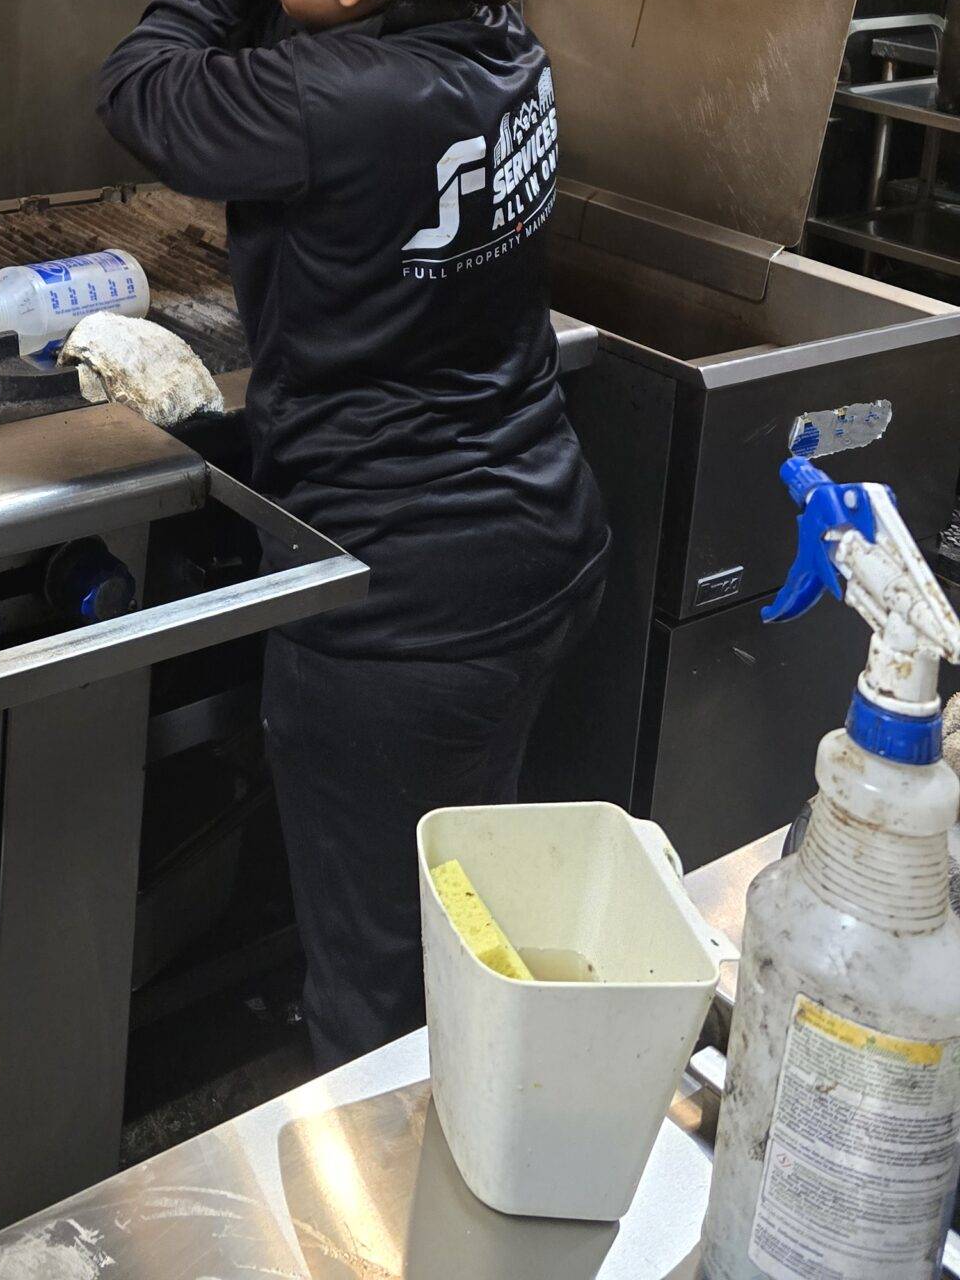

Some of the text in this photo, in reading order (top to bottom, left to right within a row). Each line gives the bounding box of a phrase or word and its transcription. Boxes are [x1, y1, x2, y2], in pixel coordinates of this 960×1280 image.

[493, 107, 558, 205] SERVICES
[492, 192, 525, 231] ALL
[525, 172, 540, 202] IN
[402, 266, 448, 279] FULL
[456, 234, 521, 272] PROPERTY
